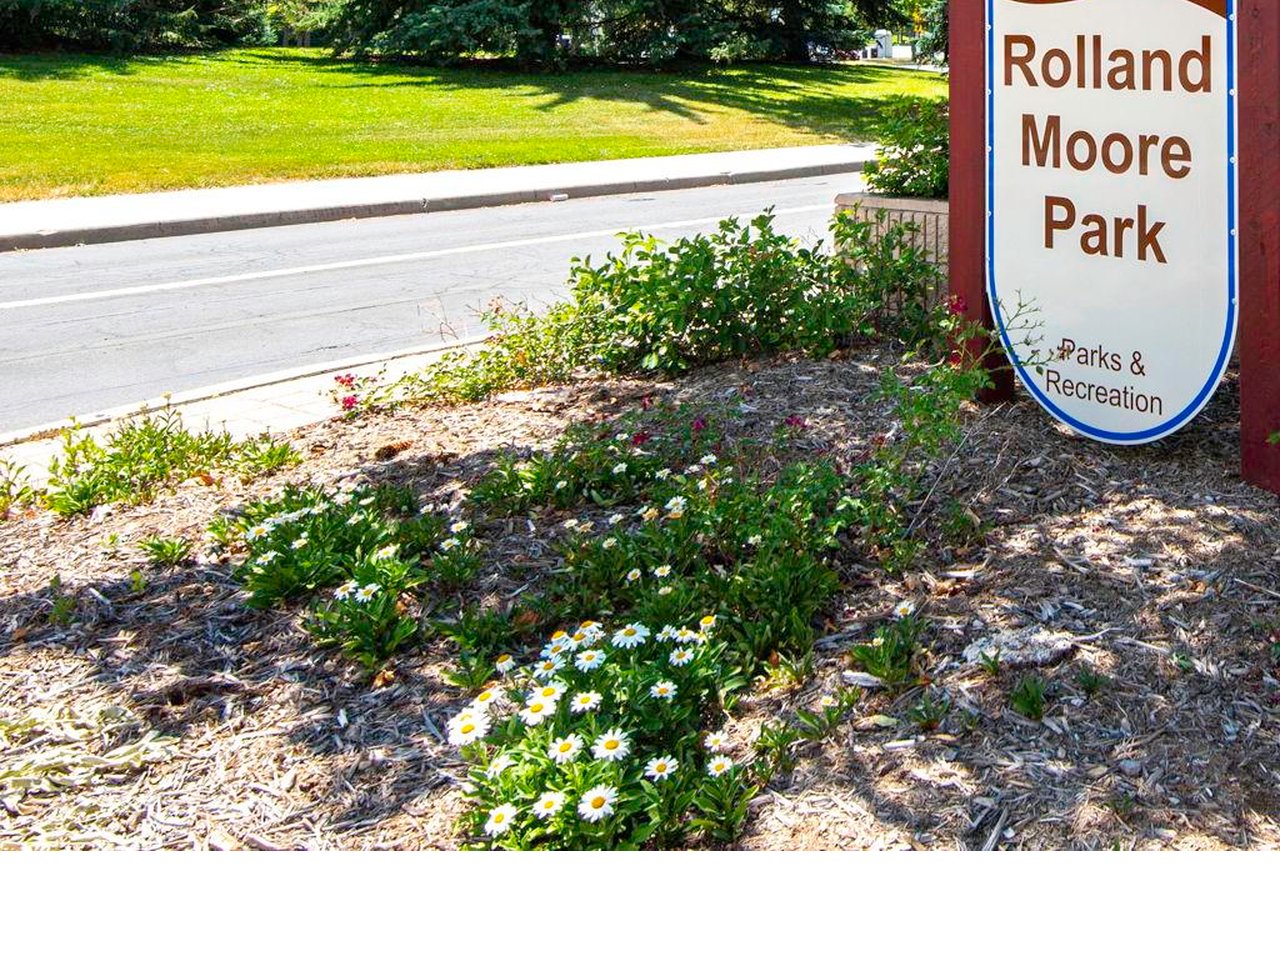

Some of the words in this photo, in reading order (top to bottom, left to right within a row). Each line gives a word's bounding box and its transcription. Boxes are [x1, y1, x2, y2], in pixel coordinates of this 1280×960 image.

[1003, 34, 1212, 93] Rolland
[1021, 113, 1192, 179] Moore
[1044, 195, 1168, 264] Park
[1061, 337, 1122, 372] Parks
[1130, 351, 1146, 376] &
[1046, 369, 1163, 416] Recreation
